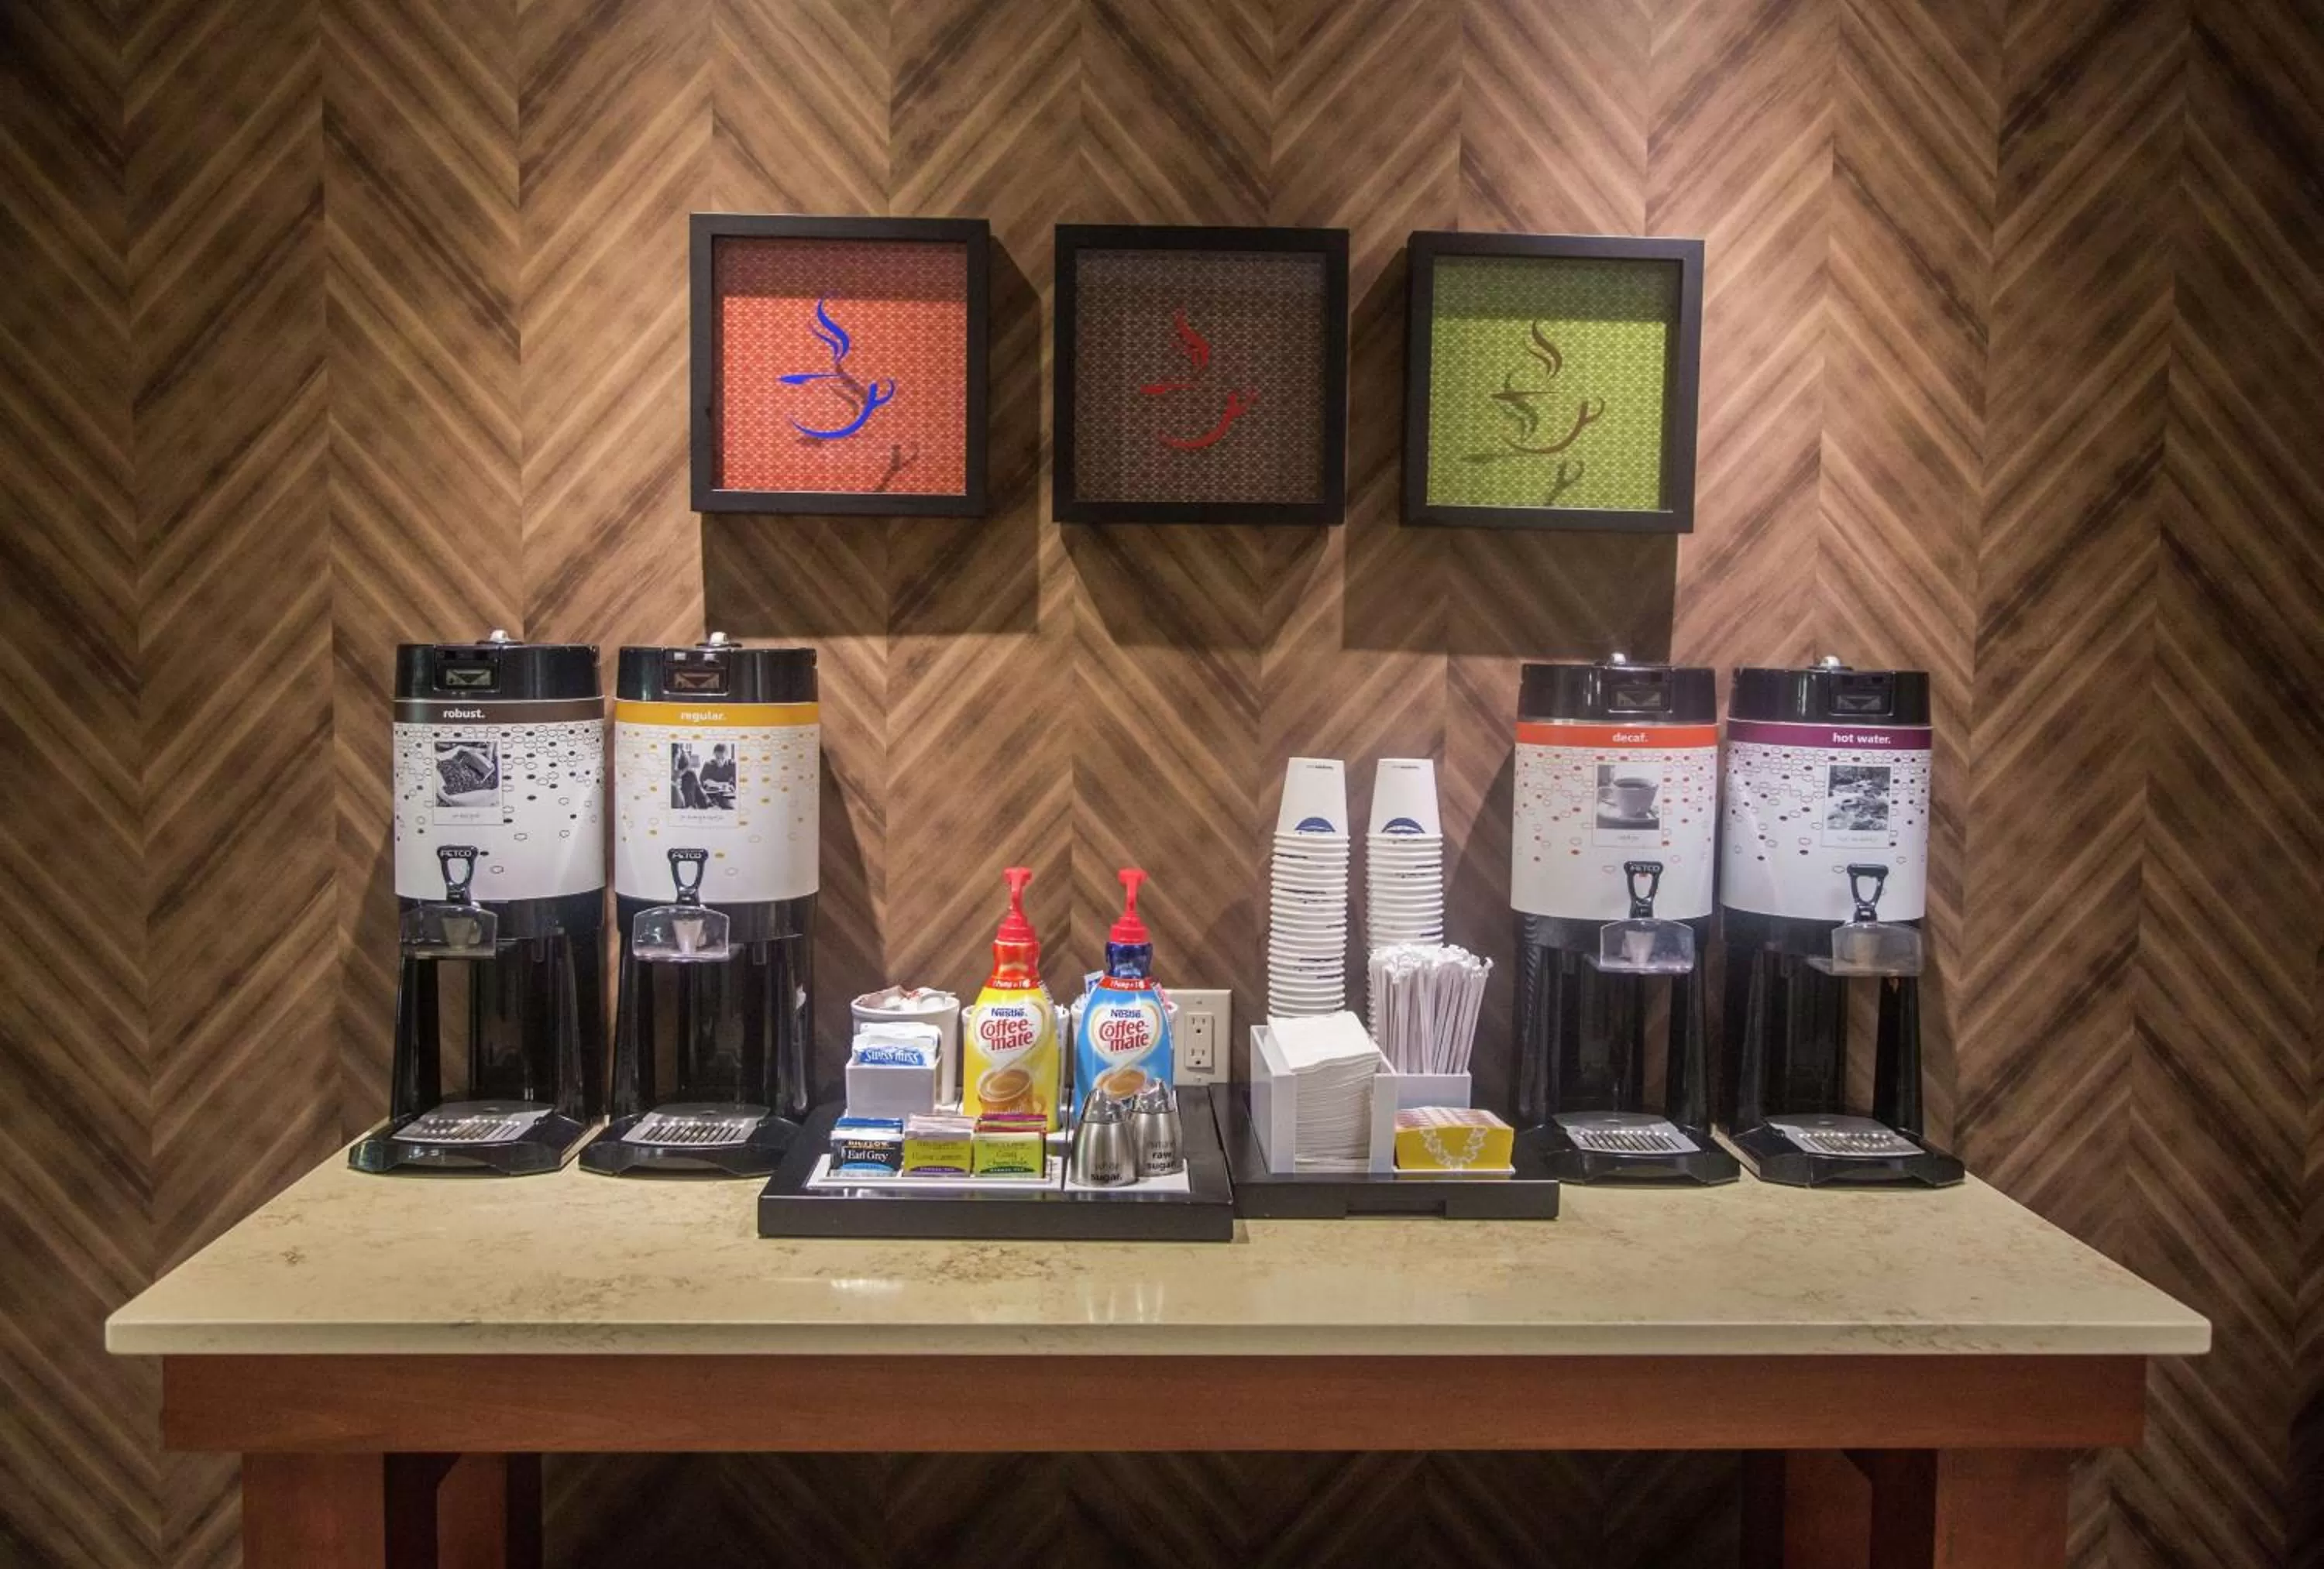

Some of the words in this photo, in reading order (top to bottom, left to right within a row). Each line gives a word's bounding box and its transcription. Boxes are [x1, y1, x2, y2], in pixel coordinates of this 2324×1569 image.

[442, 708, 486, 719] robust.
[680, 710, 727, 723] regular.
[1612, 732, 1649, 743] decaf.
[1832, 732, 1854, 743] hot
[1857, 733, 1891, 744] water.
[991, 1032, 1033, 1051] mate
[1109, 1033, 1149, 1052] mate
[847, 1149, 865, 1159] Earl
[867, 1149, 889, 1162] Grey
